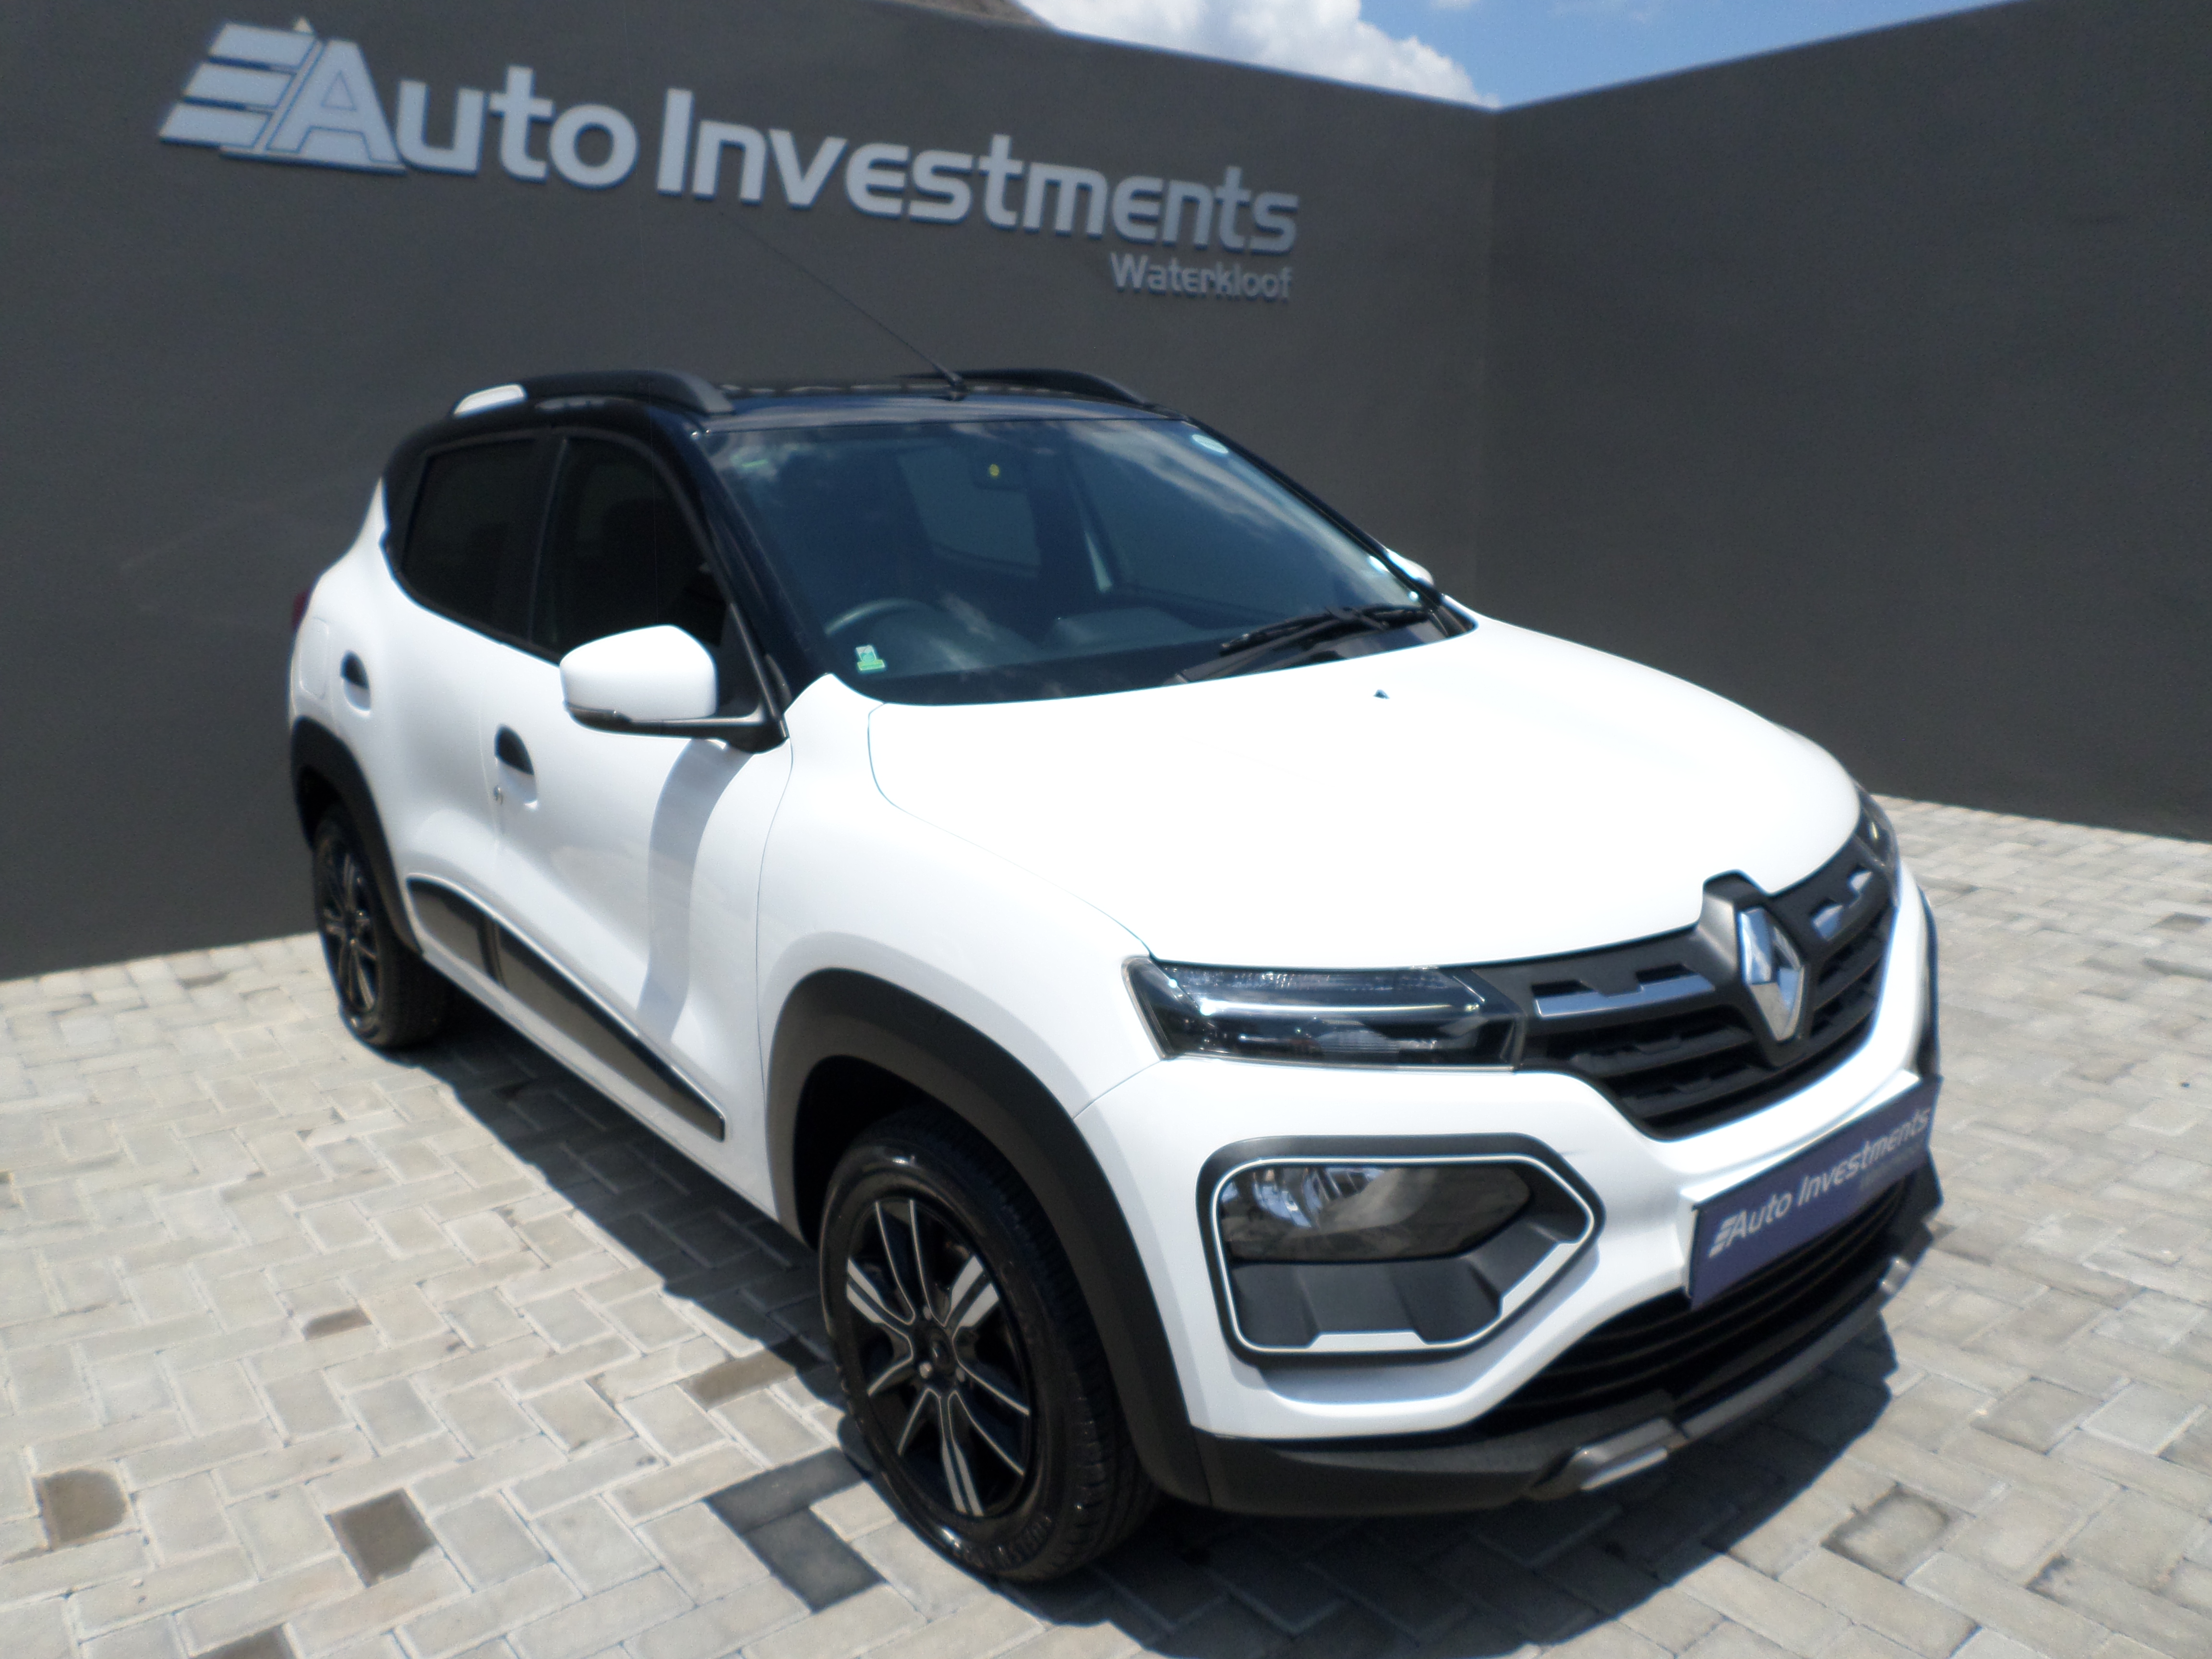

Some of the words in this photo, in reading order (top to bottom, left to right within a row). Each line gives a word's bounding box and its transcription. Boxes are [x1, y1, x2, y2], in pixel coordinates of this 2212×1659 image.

[263, 37, 639, 190] Auto
[656, 88, 1297, 252] Investments
[1110, 253, 1293, 299] Waterkloof
[1729, 1191, 1792, 1238] Auto
[1798, 1108, 1930, 1206] Investments
